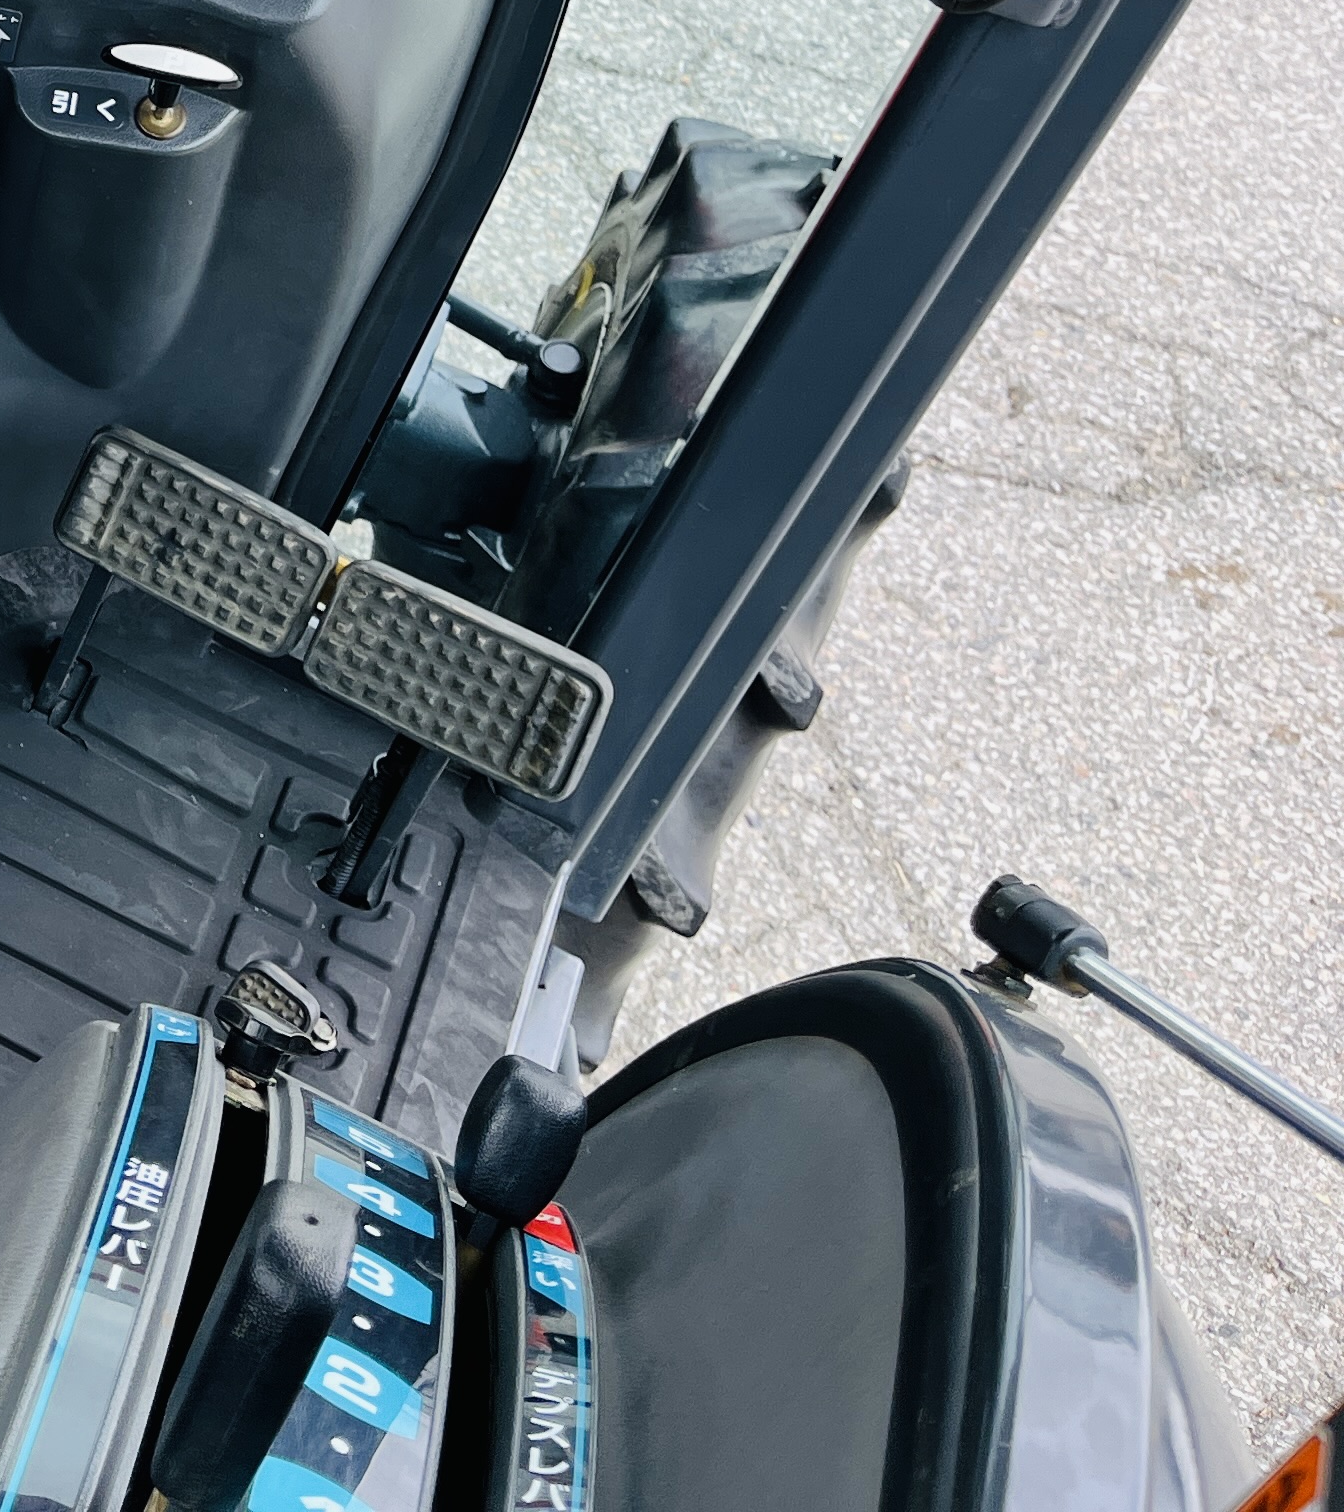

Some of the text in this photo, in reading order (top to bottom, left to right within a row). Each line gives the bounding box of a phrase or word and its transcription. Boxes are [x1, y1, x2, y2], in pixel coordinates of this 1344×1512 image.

[347, 1125, 395, 1160] 5
[346, 1182, 402, 1217] 4
[99, 1156, 171, 1292] 油圧レバー
[348, 1252, 395, 1298] 3
[322, 1352, 382, 1416] 2
